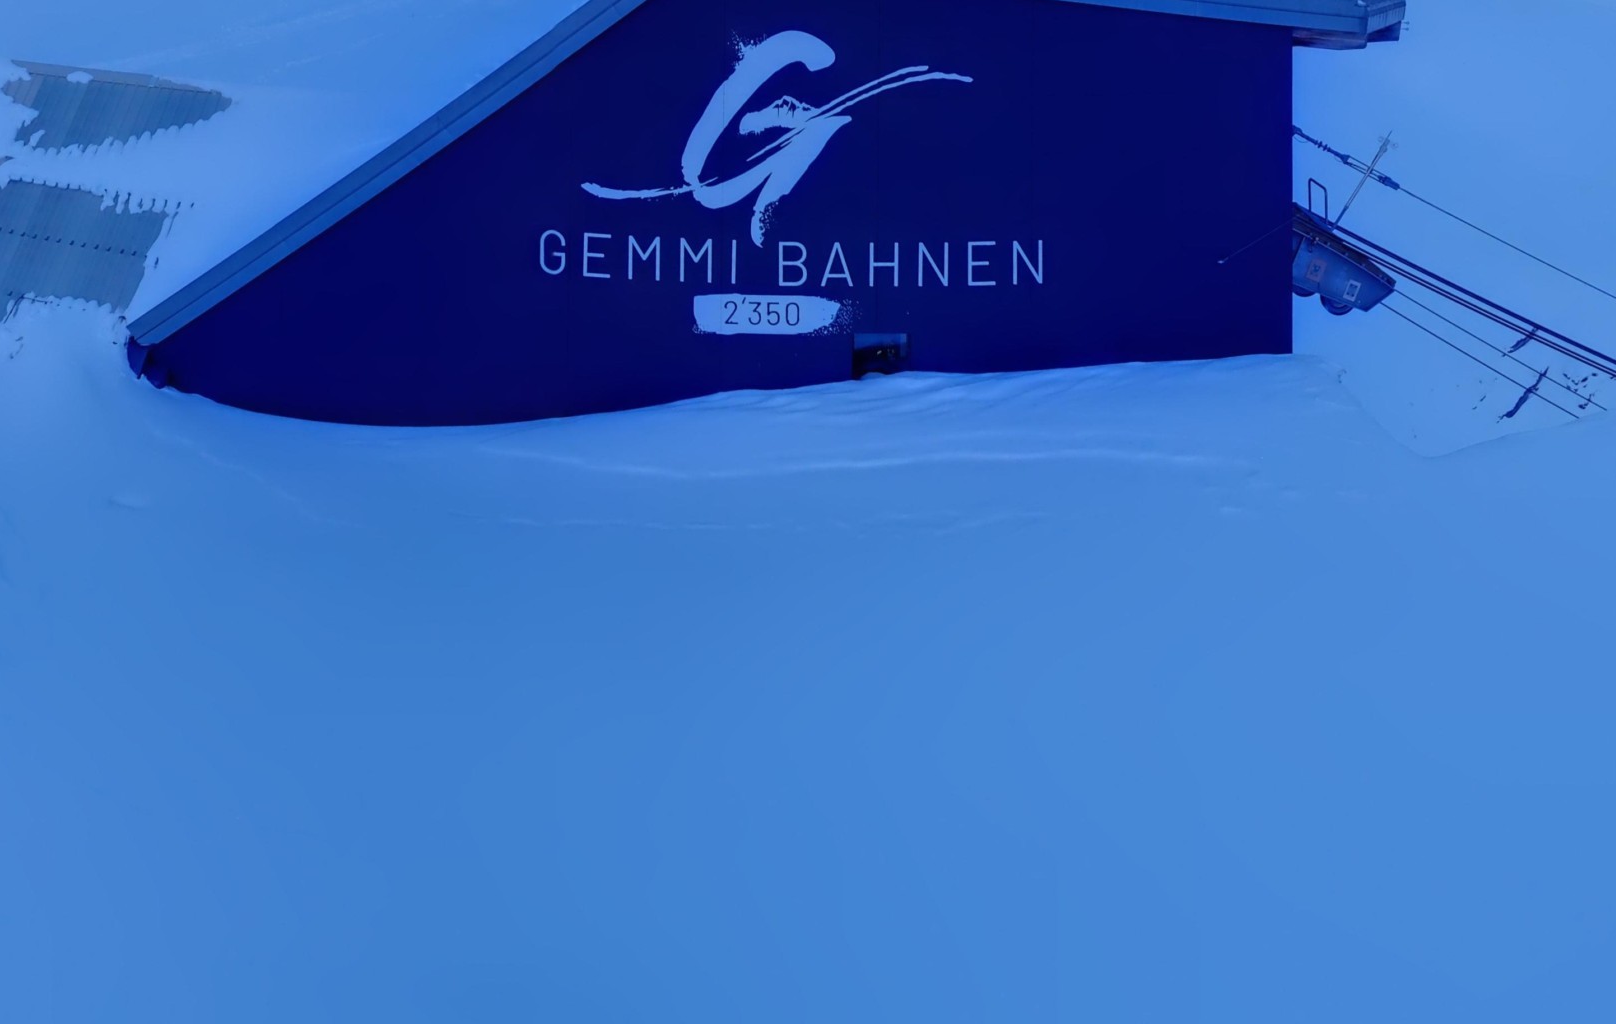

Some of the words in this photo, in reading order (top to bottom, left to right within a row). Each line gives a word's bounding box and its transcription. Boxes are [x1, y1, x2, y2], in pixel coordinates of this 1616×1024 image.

[538, 229, 738, 284] GEMMI
[777, 239, 1044, 287] BAHNEN
[723, 296, 802, 326] 2'350
